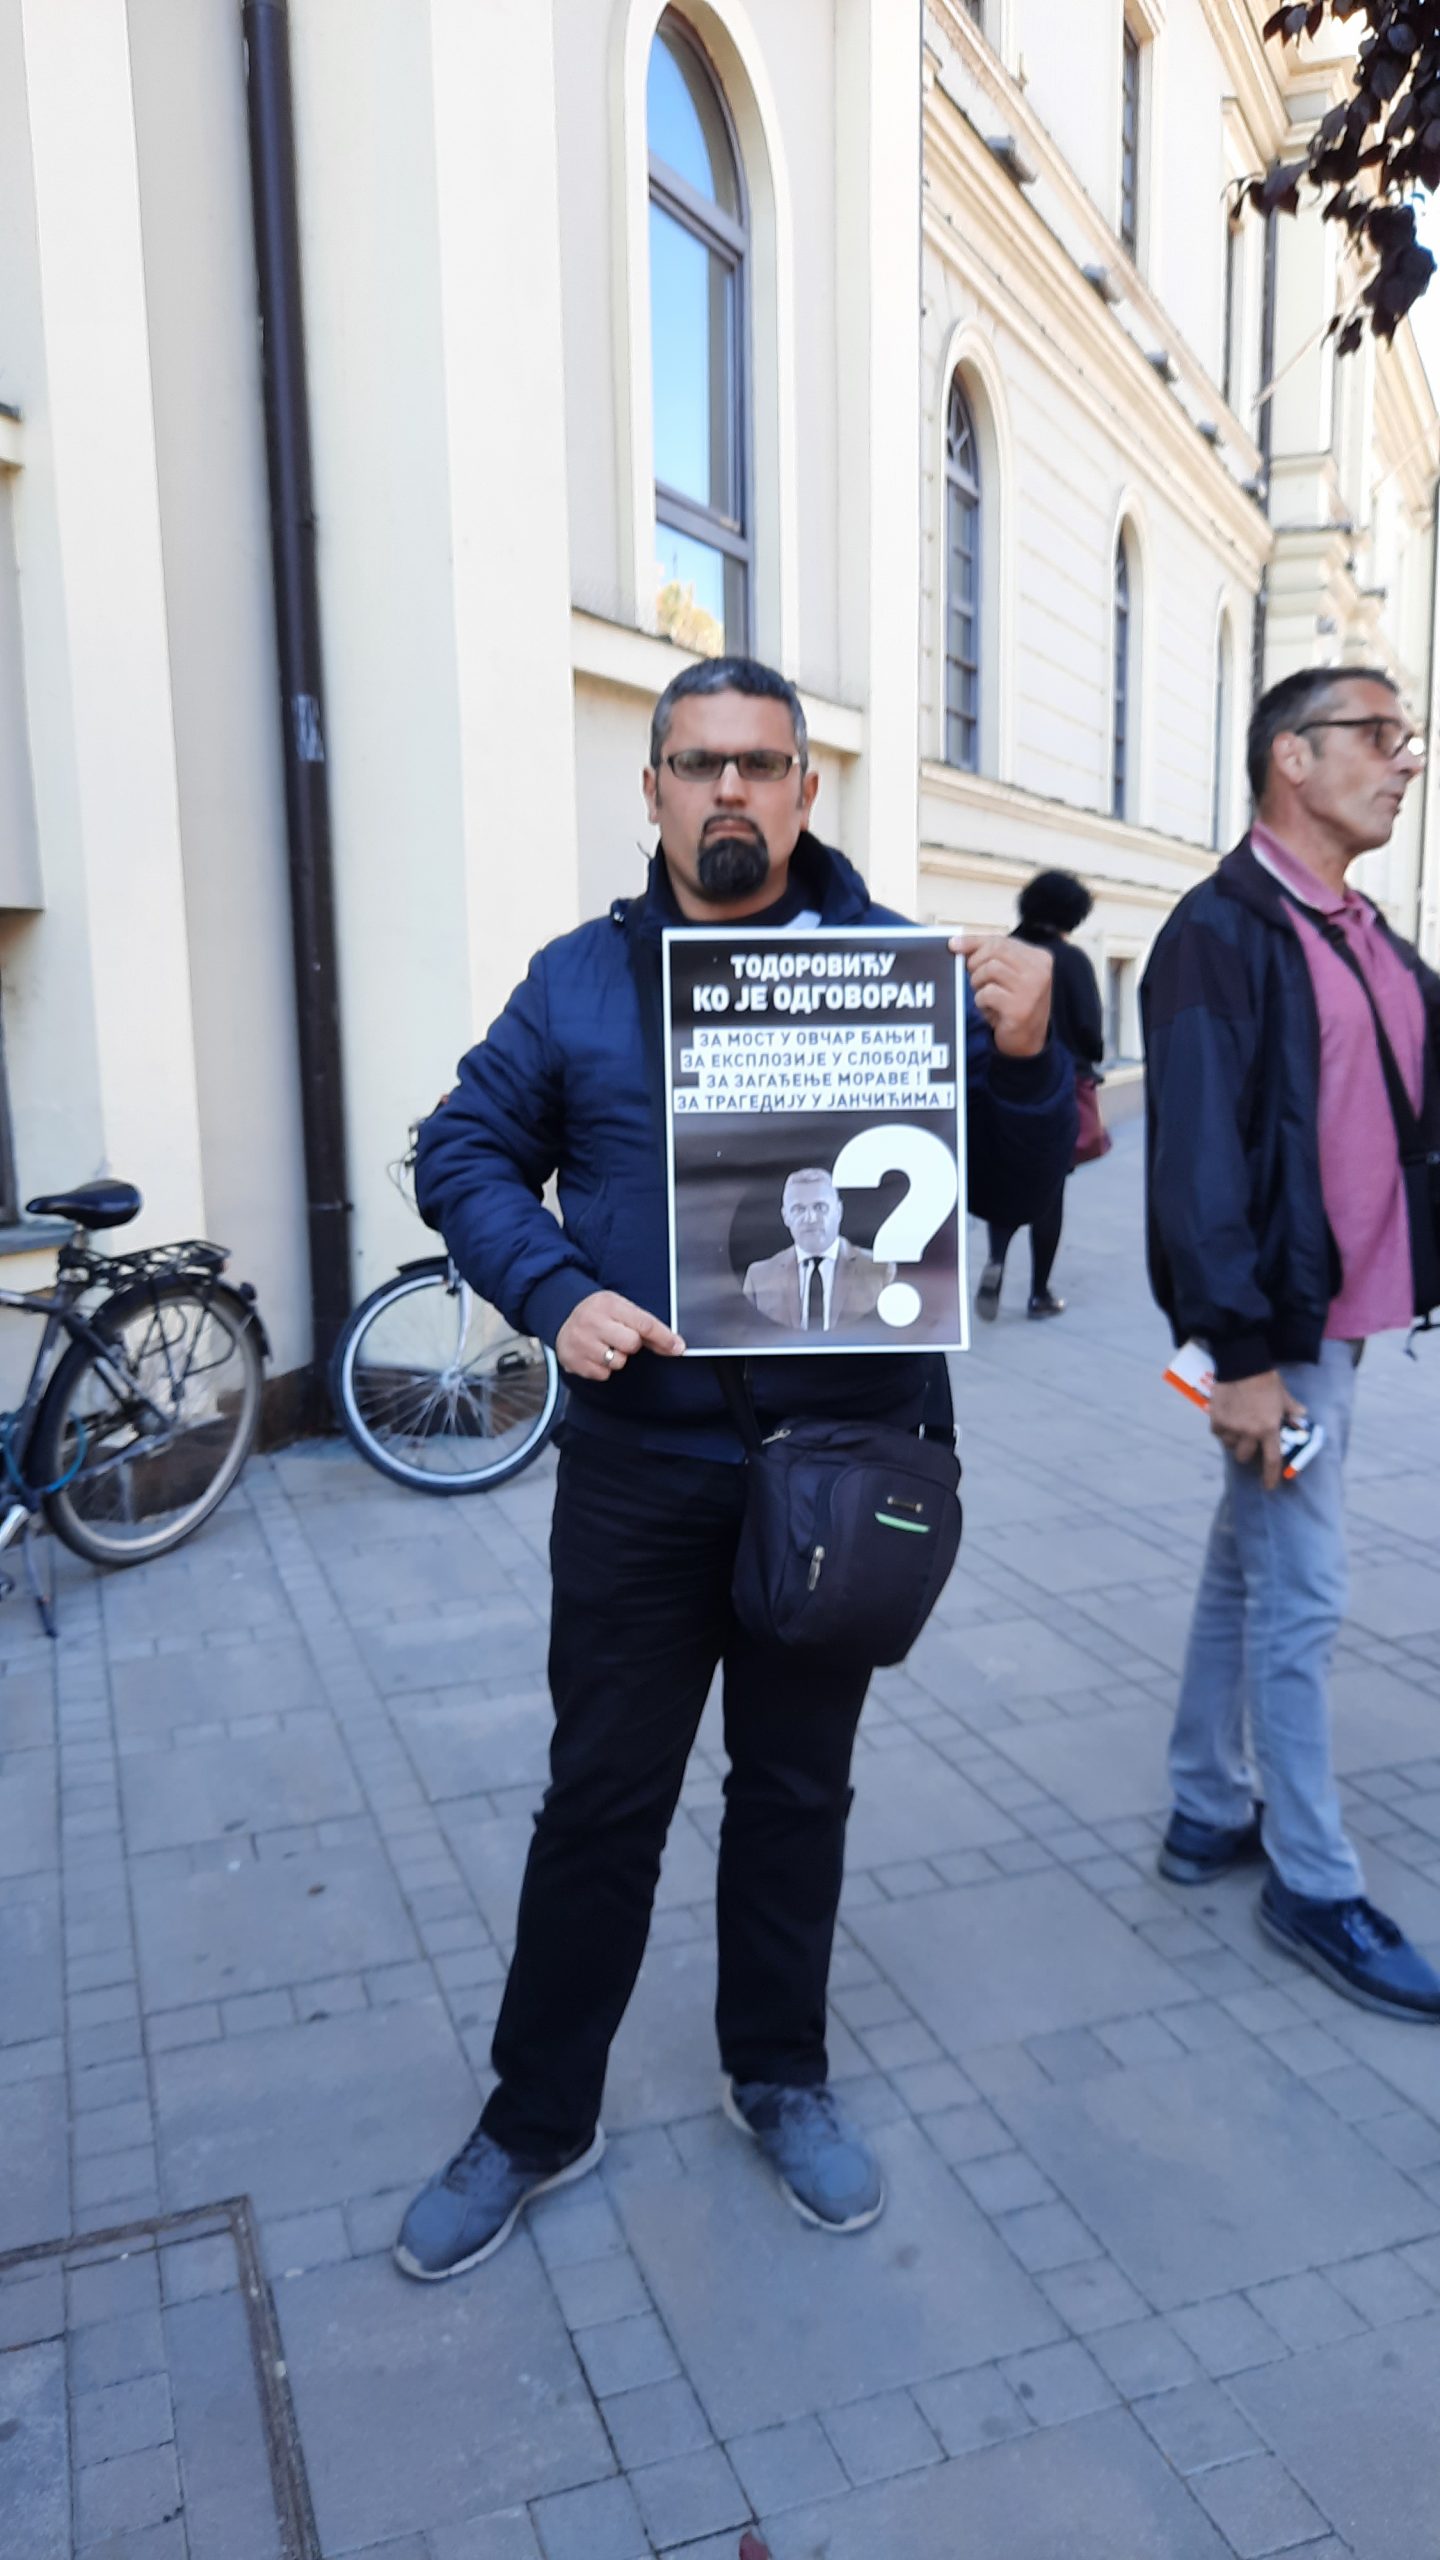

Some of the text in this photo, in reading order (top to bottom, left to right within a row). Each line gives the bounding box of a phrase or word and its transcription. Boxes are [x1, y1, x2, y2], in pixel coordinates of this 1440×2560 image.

[730, 953, 896, 981] ТОДОРОВИЋУ
[692, 982, 935, 1014] КО ЈЕ ОДГОВОРАН
[700, 1033, 721, 1046] ЗА
[728, 1032, 774, 1046] МОСТ
[782, 1032, 791, 1045] У
[796, 1031, 855, 1046] ОВЧАР
[861, 1030, 916, 1044] БАЊИ
[683, 1054, 705, 1068] ЗА
[712, 1052, 826, 1068] ЕКСПЛОЗИЈЕ
[833, 1052, 842, 1066] У
[848, 1051, 932, 1068] СЛОБОДИ
[707, 1075, 728, 1088] ЗА
[734, 1073, 832, 1088] ЗАГАЂЕЊЕ
[838, 1072, 910, 1085] МОРАВЕ
[678, 1096, 699, 1110] ЗА
[706, 1094, 806, 1113] ТРАГЕДИЈУ
[812, 1094, 822, 1107] У
[827, 1092, 939, 1108] ЈАНЧИЋИМА
[832, 1124, 958, 1328] ?
